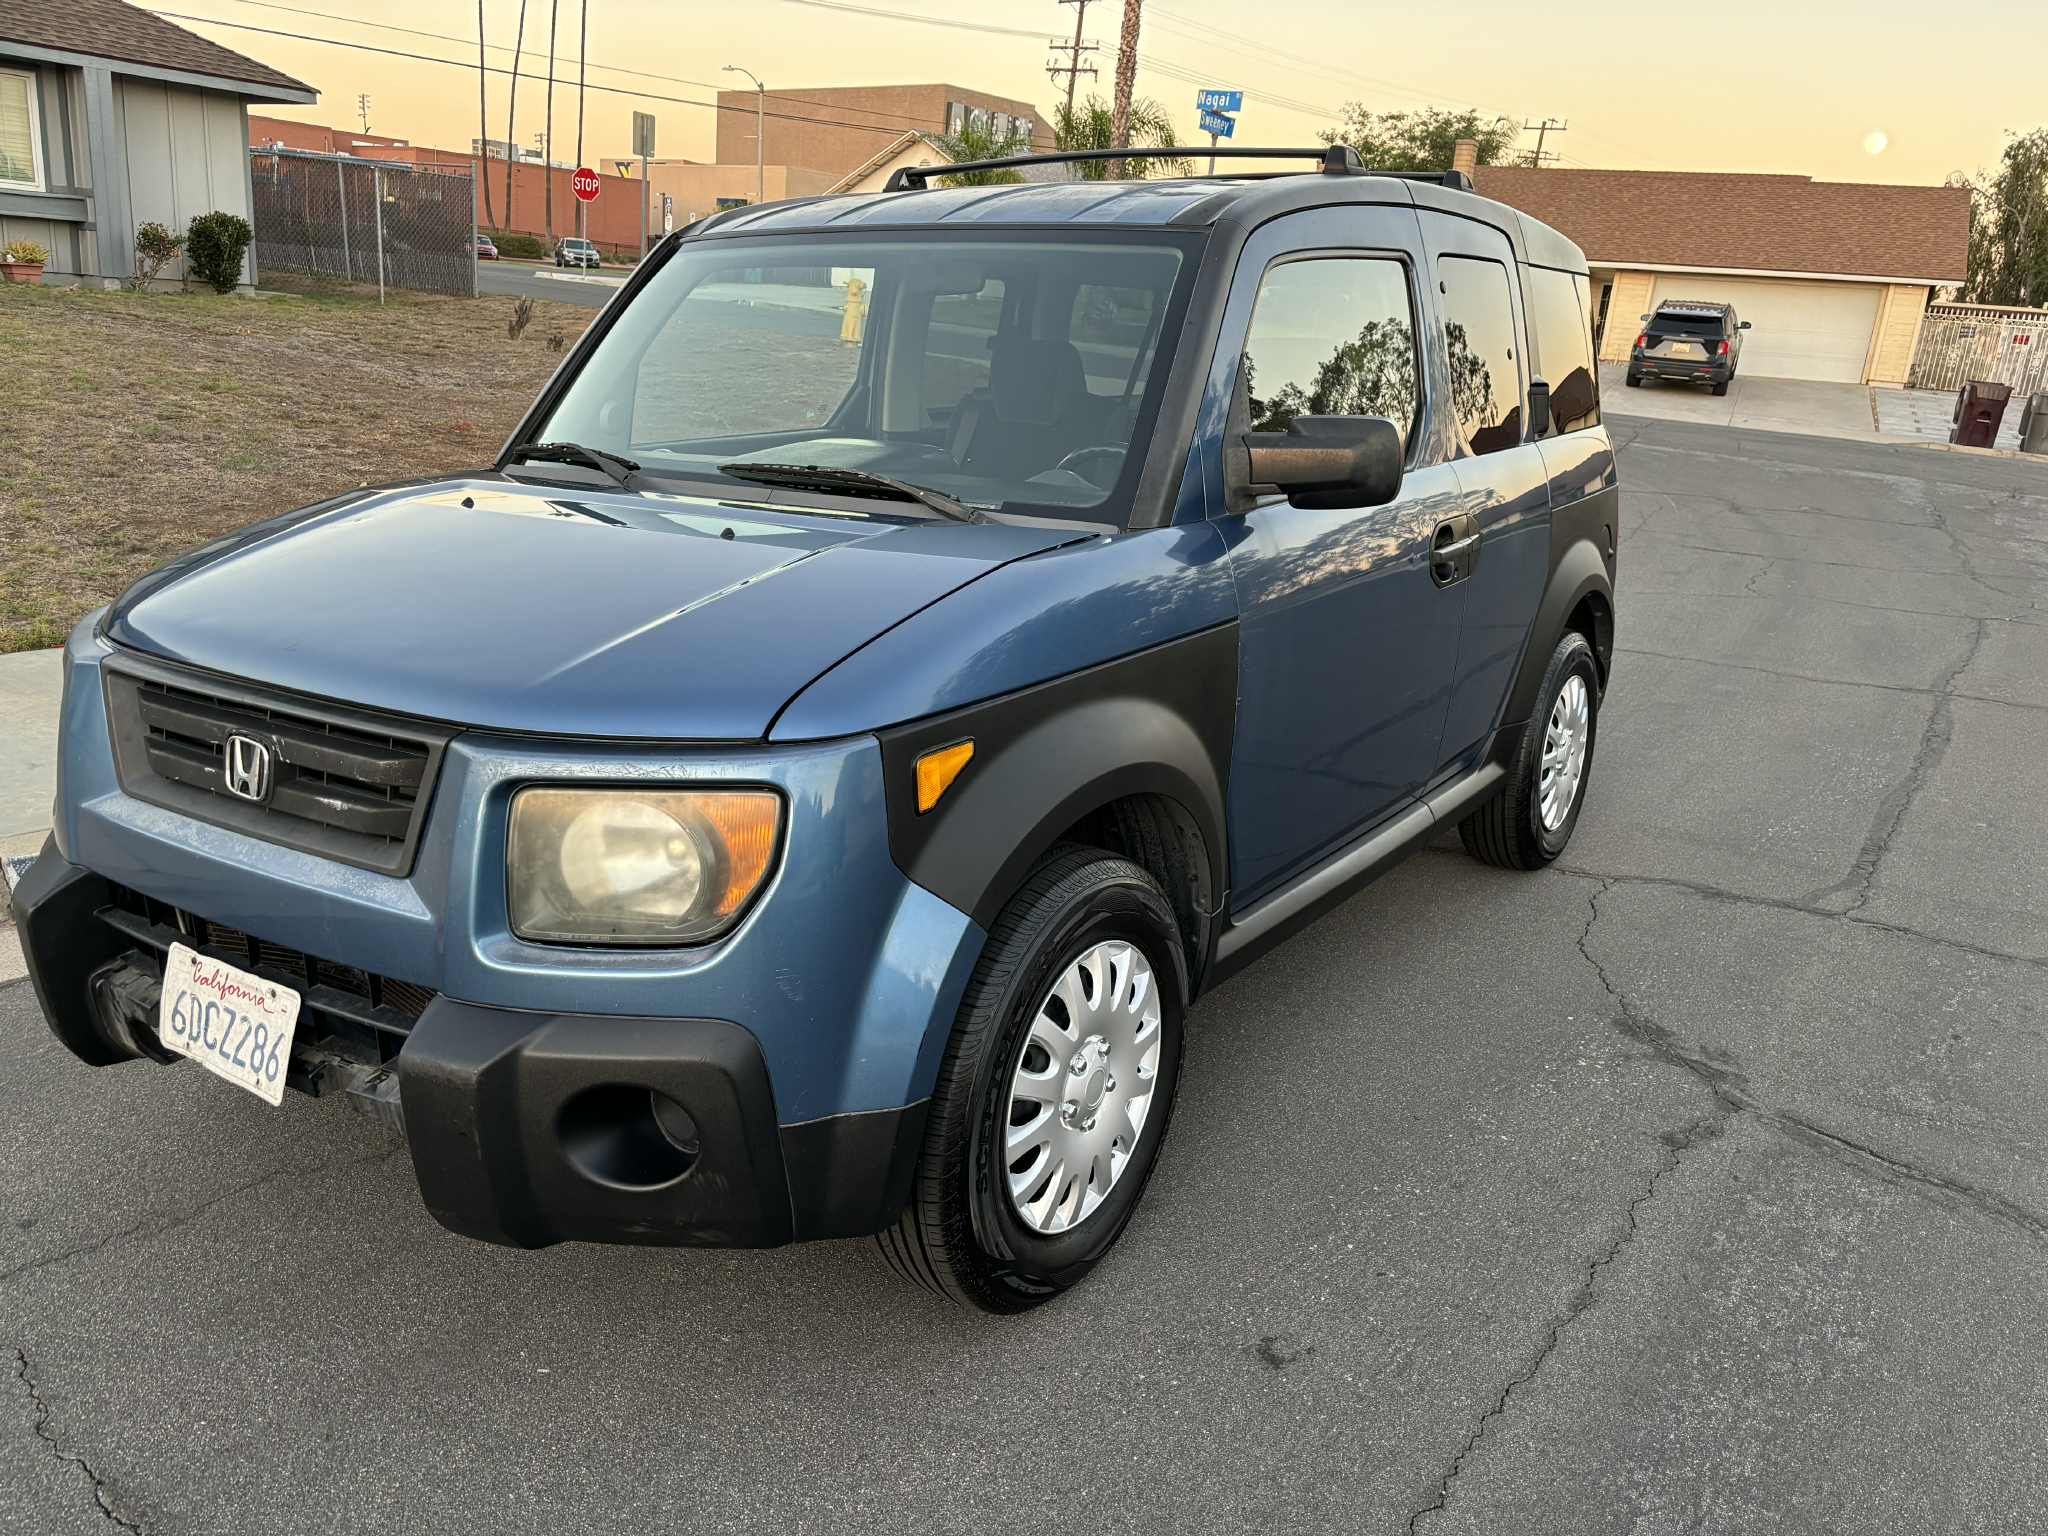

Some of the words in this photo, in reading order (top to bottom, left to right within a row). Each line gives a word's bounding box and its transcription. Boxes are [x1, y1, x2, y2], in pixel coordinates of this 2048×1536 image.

[574, 177, 599, 192] STOP
[193, 961, 274, 1014] California
[171, 990, 286, 1082] 6DCZ286
